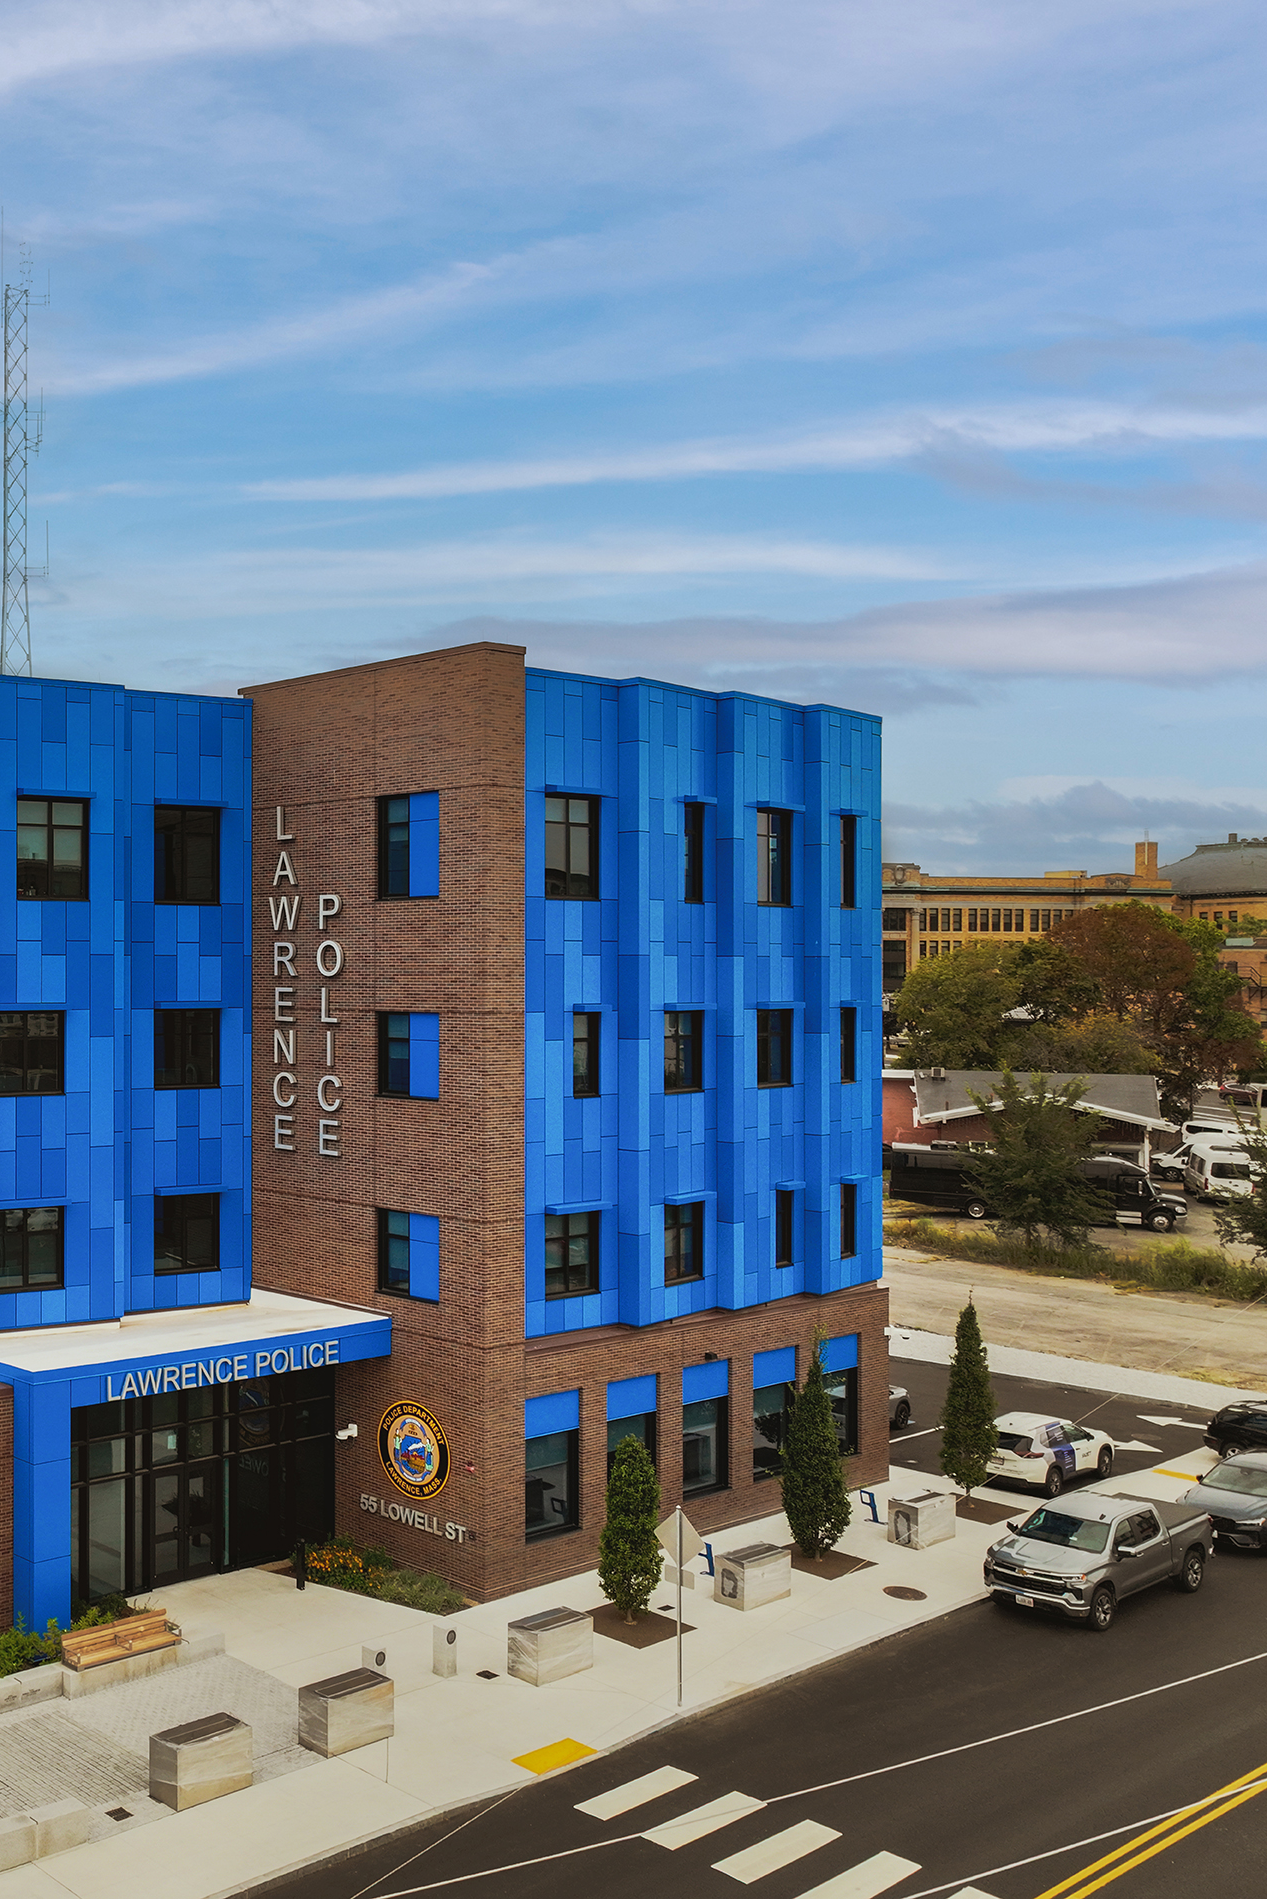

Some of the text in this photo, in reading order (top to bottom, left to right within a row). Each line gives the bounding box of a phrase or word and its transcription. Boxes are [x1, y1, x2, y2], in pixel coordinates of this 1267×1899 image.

[269, 806, 300, 1150] LAWRENCE
[316, 894, 343, 1157] POLICE
[107, 1340, 339, 1402] LAWRENCE POLICE
[383, 1405, 445, 1446] POLICE DEPARTMENT
[386, 1461, 423, 1496] LAWRENCE,
[359, 1493, 467, 1543] 55 LOWELL ST
